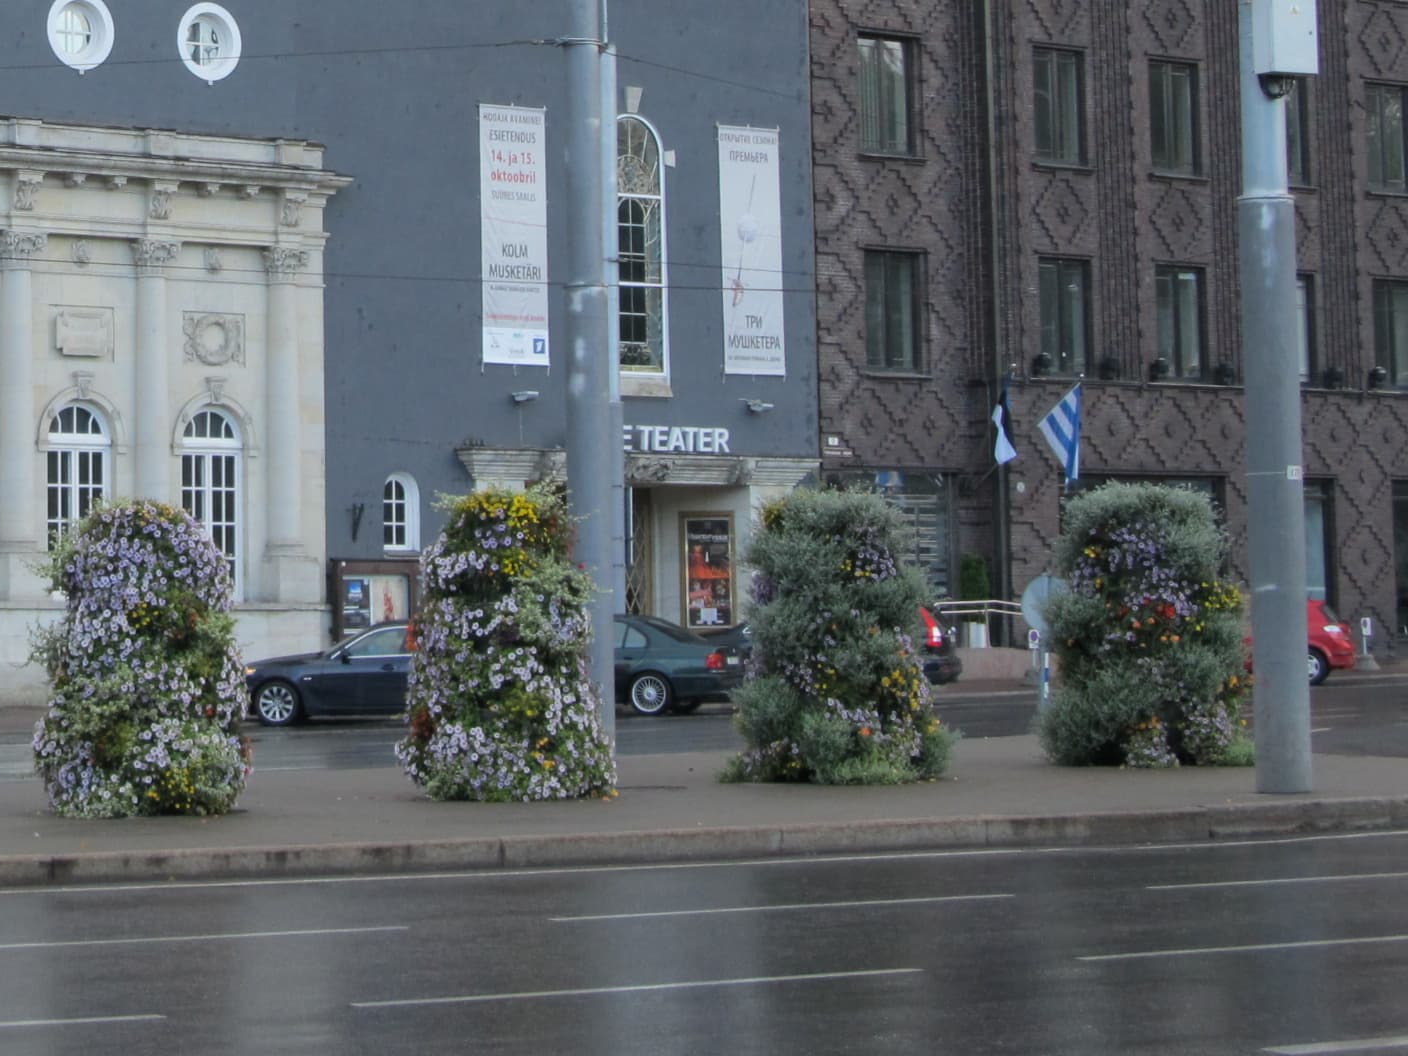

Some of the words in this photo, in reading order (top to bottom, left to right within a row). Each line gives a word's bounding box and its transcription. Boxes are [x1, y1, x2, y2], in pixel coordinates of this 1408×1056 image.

[489, 130, 536, 144] ESIETENDUS
[491, 149, 506, 162] 14.
[509, 151, 518, 166] ja
[521, 153, 536, 165] 15.
[730, 150, 769, 164] ПРЕМЬЕРА
[491, 170, 536, 184] oktoobril
[502, 244, 528, 258] KOLM
[489, 263, 541, 280] MUSKETÄRI
[745, 315, 763, 329] ТРИ
[728, 335, 781, 350] МУШКЕТЕРА
[636, 426, 730, 453] TEATER
